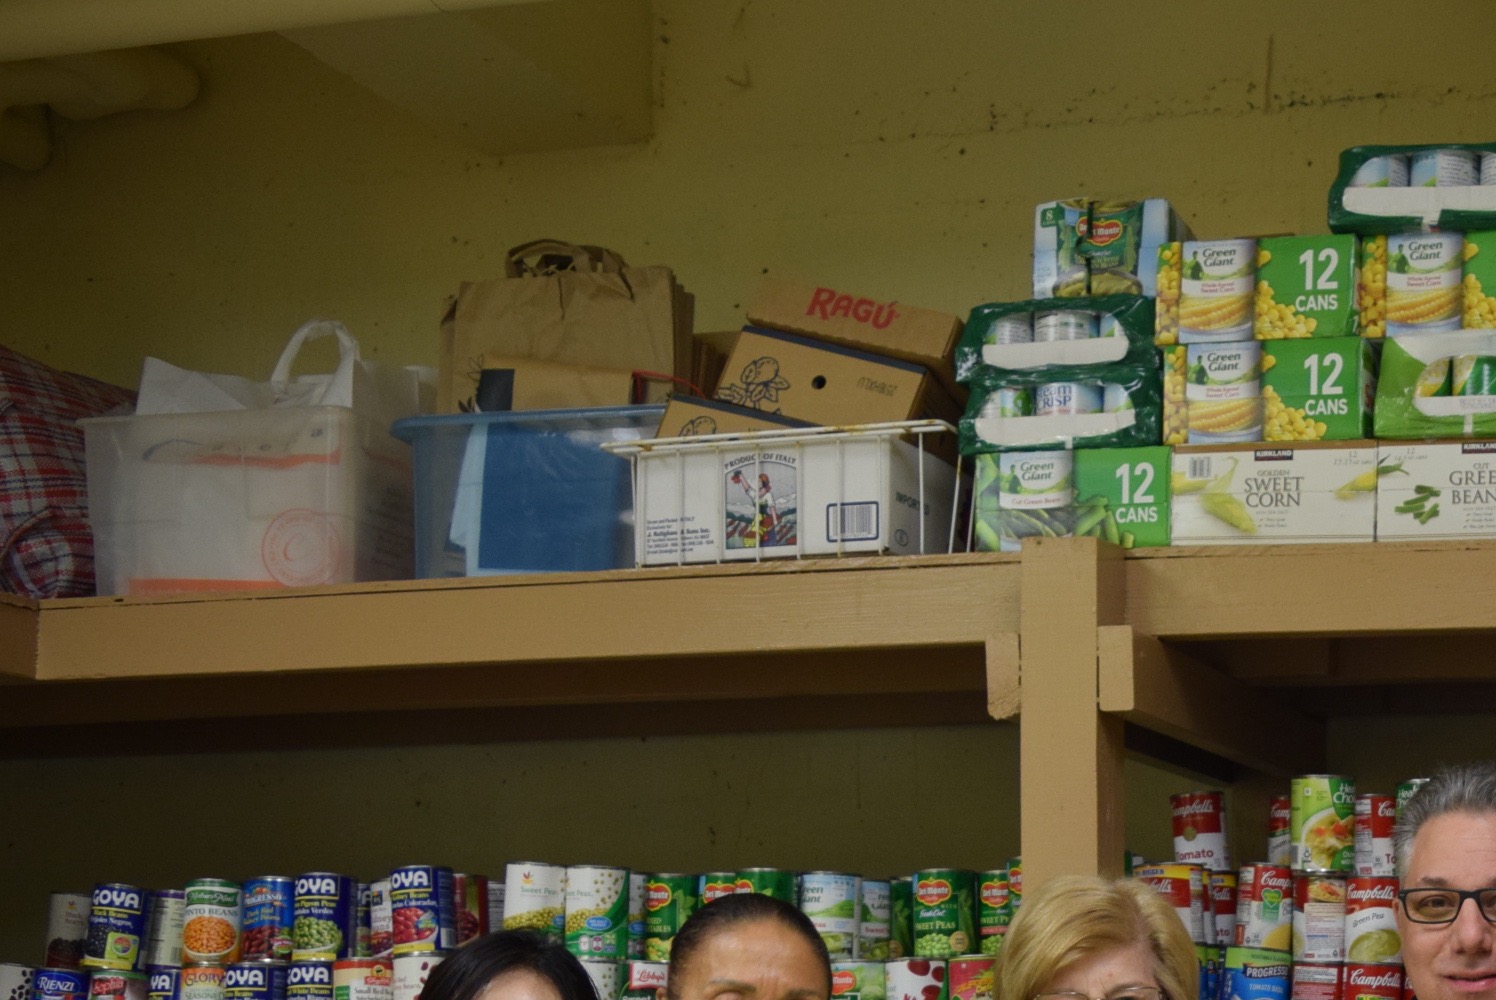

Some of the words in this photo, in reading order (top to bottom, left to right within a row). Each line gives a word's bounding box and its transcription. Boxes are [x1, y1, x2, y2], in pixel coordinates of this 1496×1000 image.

[1408, 242, 1443, 251] Green
[1202, 248, 1236, 258] Green
[1409, 251, 1441, 261] Giant
[1203, 257, 1234, 267] Giant
[1299, 248, 1338, 290] 12
[1296, 295, 1338, 312] CANS
[1207, 353, 1241, 362] Green
[1208, 361, 1239, 372] Giant
[1304, 353, 1343, 395] 12
[1305, 399, 1348, 416] CANS
[776, 453, 796, 464] ITALY
[1020, 462, 1054, 471] Green
[1021, 470, 1053, 481] Giant
[1115, 462, 1154, 504] 12
[1244, 477, 1304, 493] SWEET
[1246, 493, 1300, 507] CORN
[1116, 507, 1158, 523] CANS
[926, 887, 949, 895] Monte
[1348, 884, 1393, 900] Campbell's
[935, 920, 955, 929] PEAS
[1353, 915, 1370, 928] Green
[1372, 913, 1384, 921] Pea
[638, 968, 666, 982] Libby's
[1246, 967, 1288, 978] PROGRESSO
[37, 977, 75, 992] RIENZI
